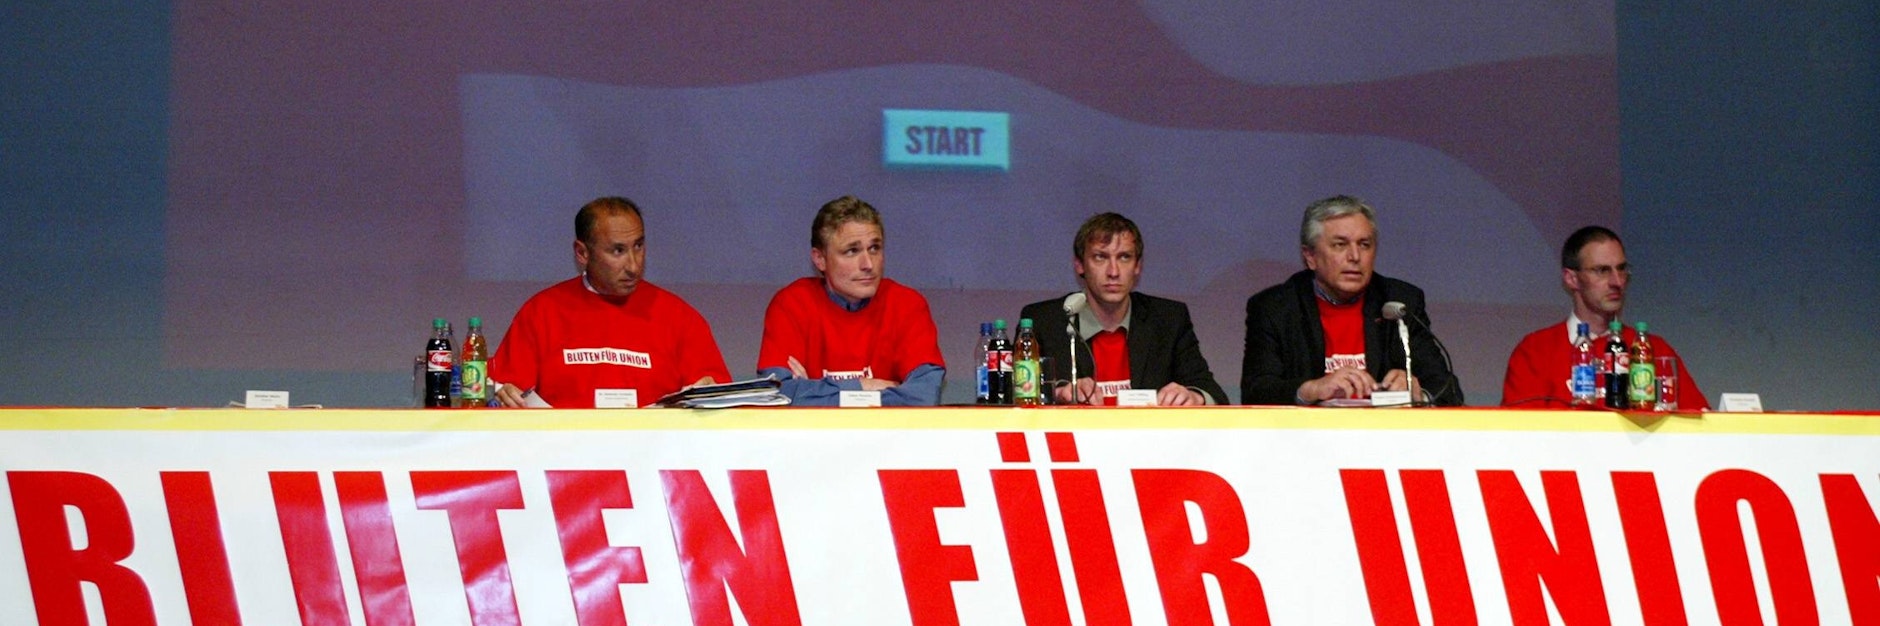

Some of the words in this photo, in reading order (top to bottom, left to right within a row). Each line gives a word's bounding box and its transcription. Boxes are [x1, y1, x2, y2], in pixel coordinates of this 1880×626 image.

[905, 125, 986, 156] START
[566, 352, 600, 362] BLUTEN
[601, 349, 618, 362] FÜR
[619, 352, 649, 366] UNION
[6, 470, 802, 626] BLUTEN
[876, 432, 1272, 626] FÜR
